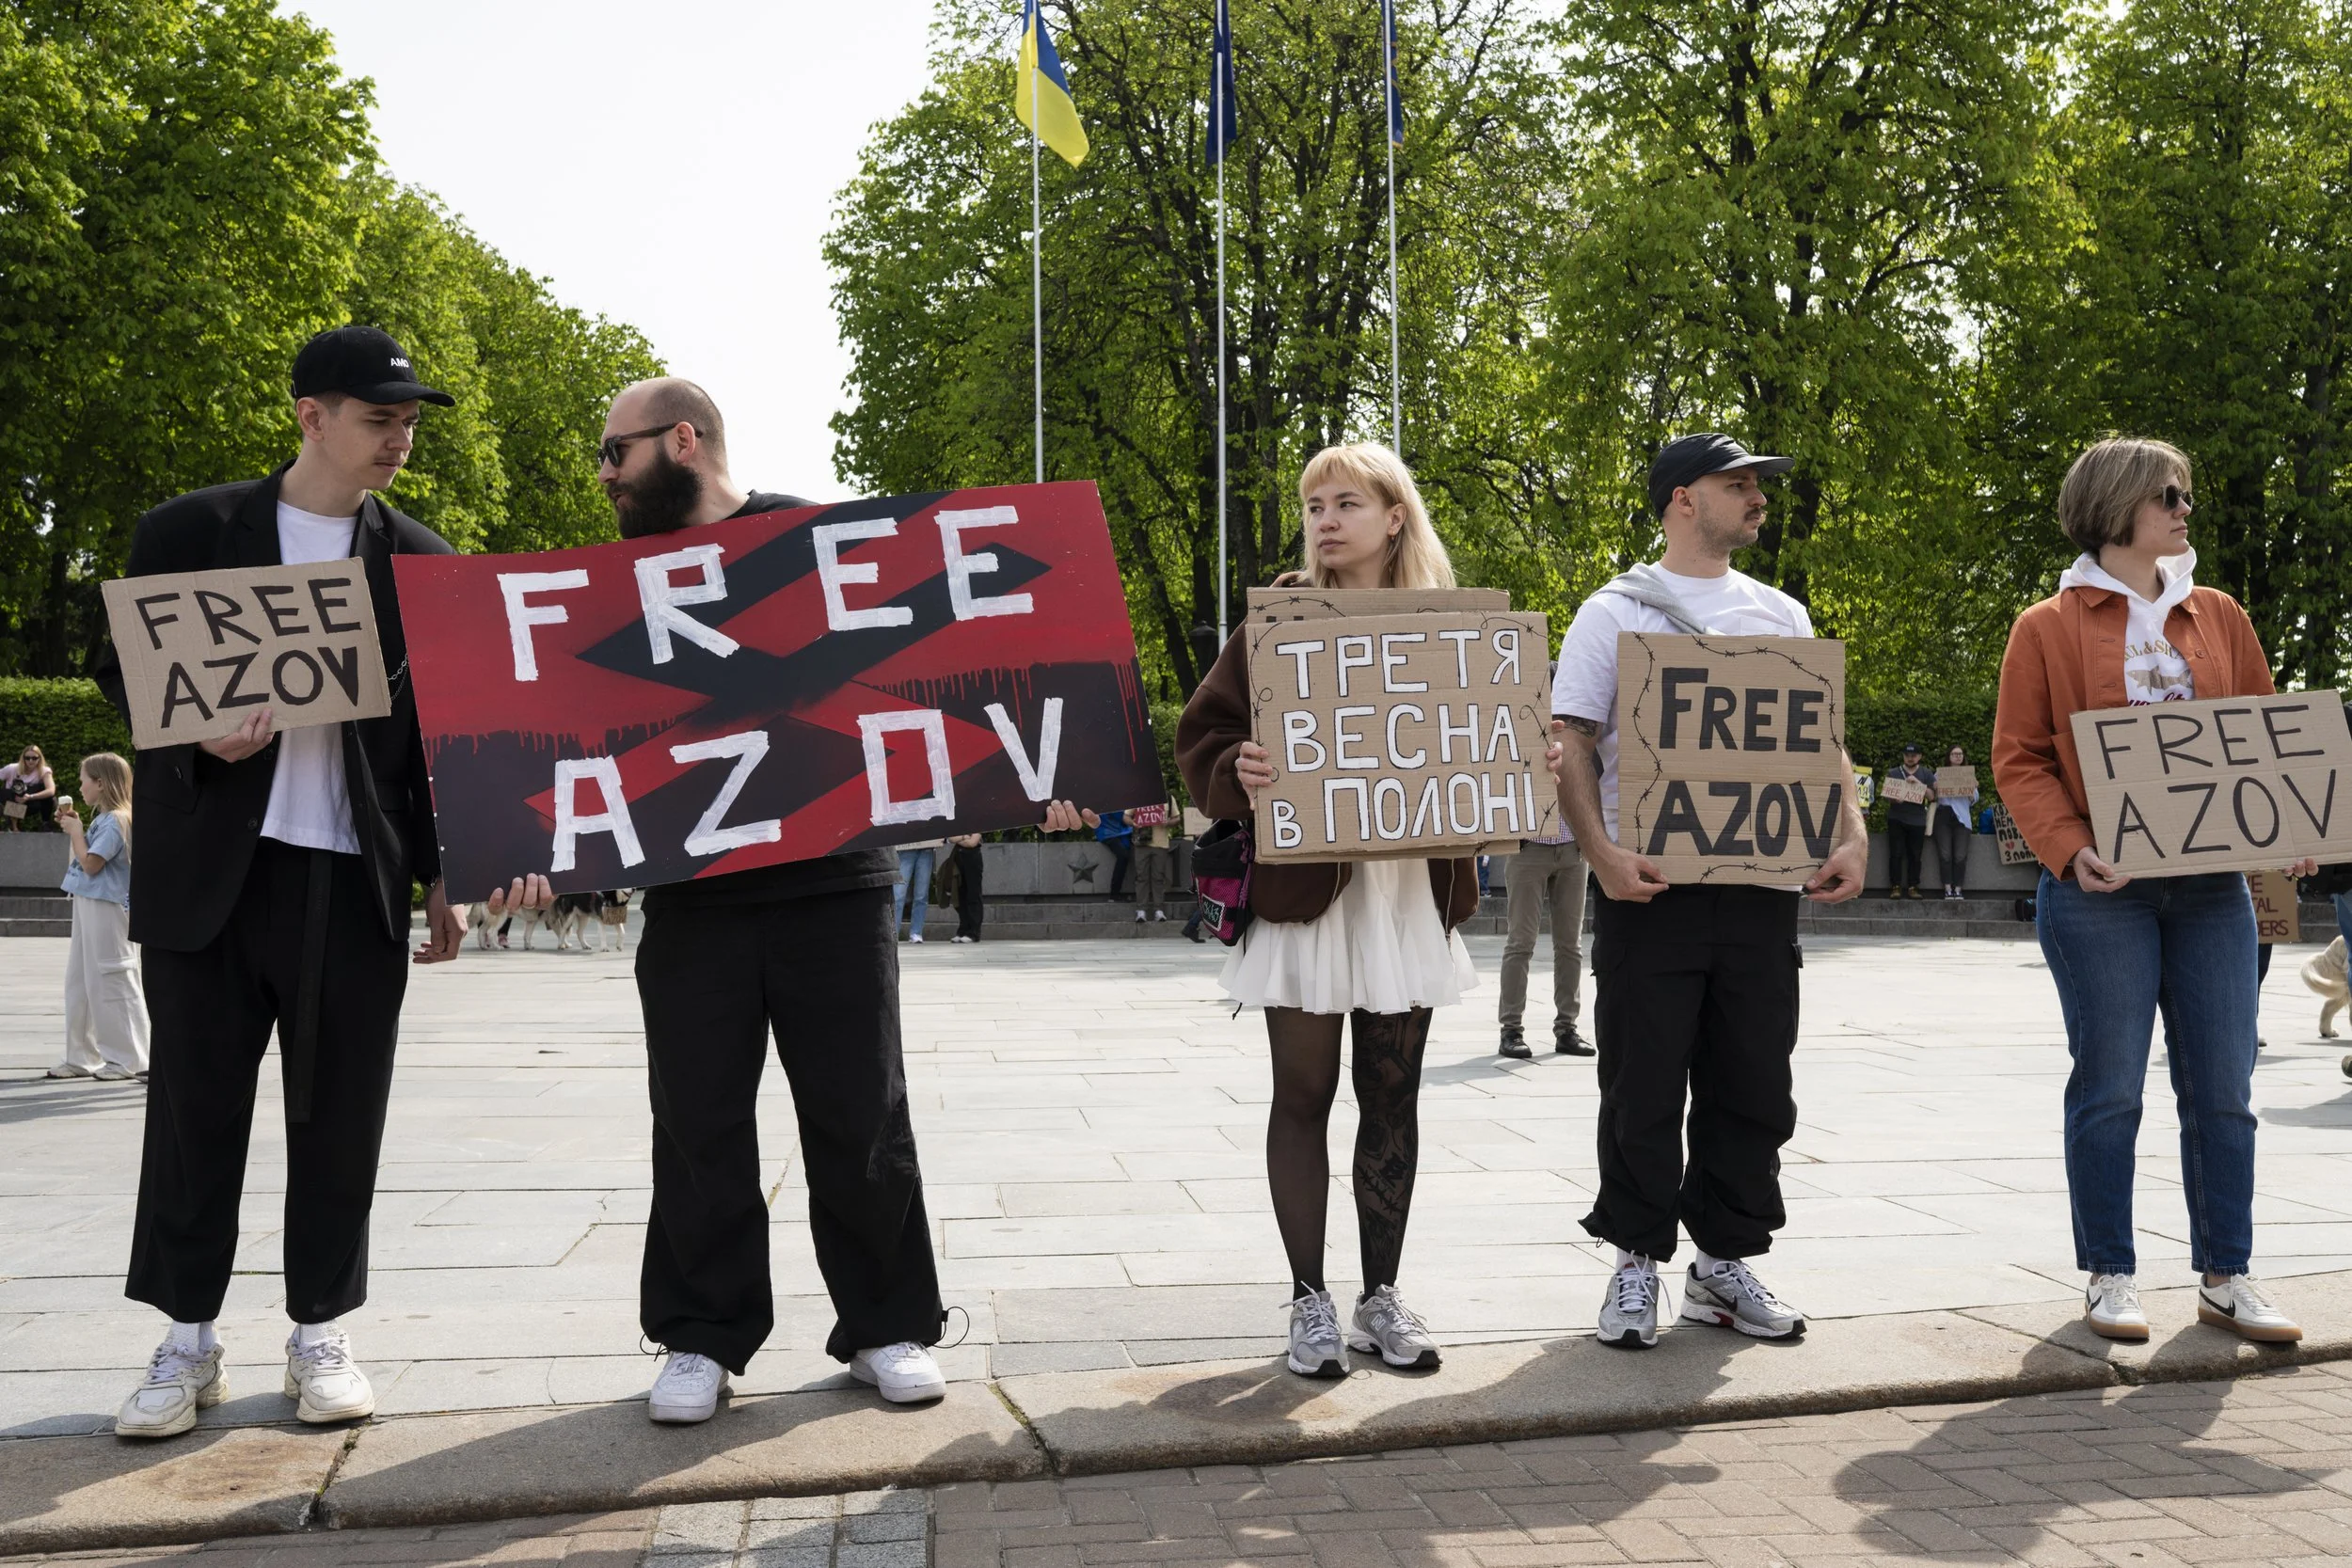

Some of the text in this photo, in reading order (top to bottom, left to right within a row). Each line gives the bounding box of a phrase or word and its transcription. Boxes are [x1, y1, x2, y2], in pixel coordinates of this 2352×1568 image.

[134, 578, 361, 650] FREE
[497, 505, 1034, 681] FREE
[161, 646, 358, 729] AZOV
[1276, 628, 1521, 699] ТРЕТЯ
[1282, 703, 1520, 773] ВЕСНА
[1659, 667, 1824, 752] FREE
[2094, 705, 2325, 780] FREE
[551, 698, 1063, 872] AZOV
[1323, 772, 1537, 843] ПОЛОНІ
[1646, 780, 1842, 859] AZOV
[2114, 768, 2336, 863] AZOV
